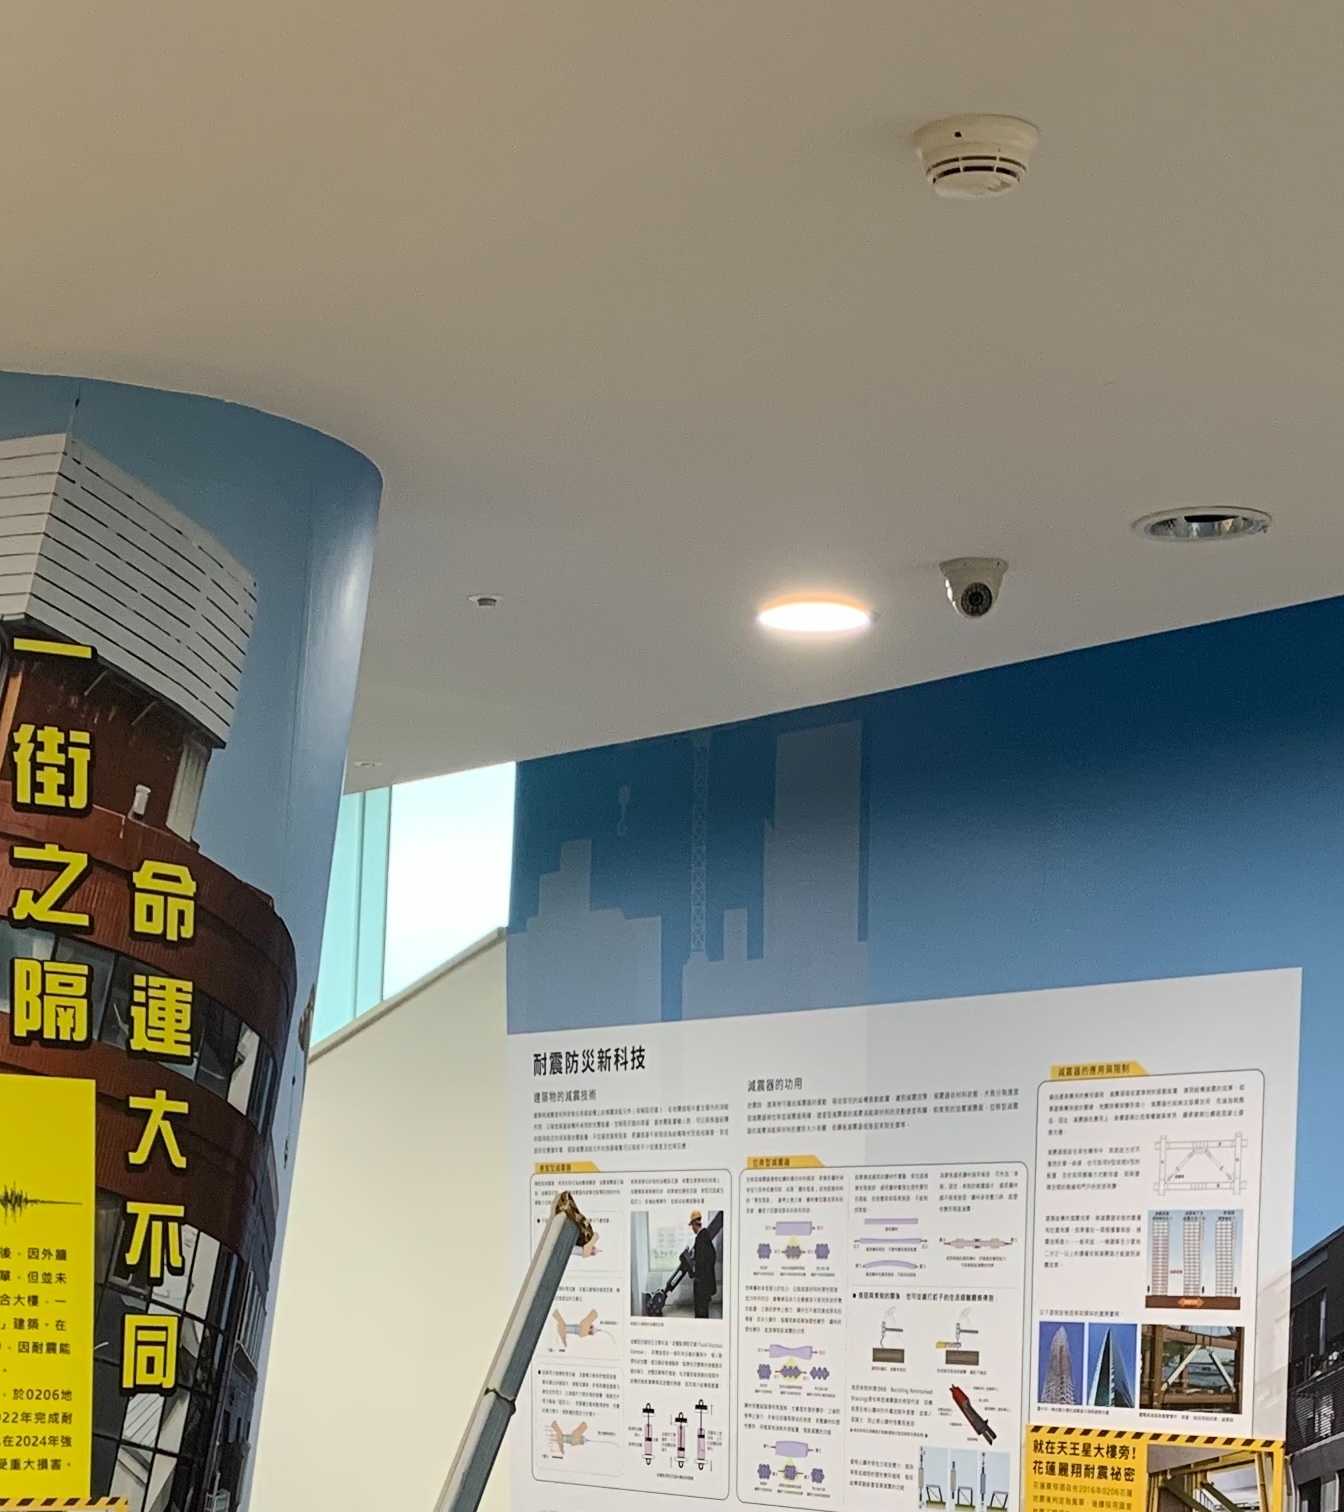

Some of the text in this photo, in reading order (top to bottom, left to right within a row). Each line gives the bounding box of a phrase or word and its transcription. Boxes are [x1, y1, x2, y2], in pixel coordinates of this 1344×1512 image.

[13, 638, 93, 1041] 一街之隔
[122, 860, 197, 1390] 命運大不同
[533, 1045, 646, 1077] 耐震防災新科技
[747, 1077, 803, 1092] 減震器的功用
